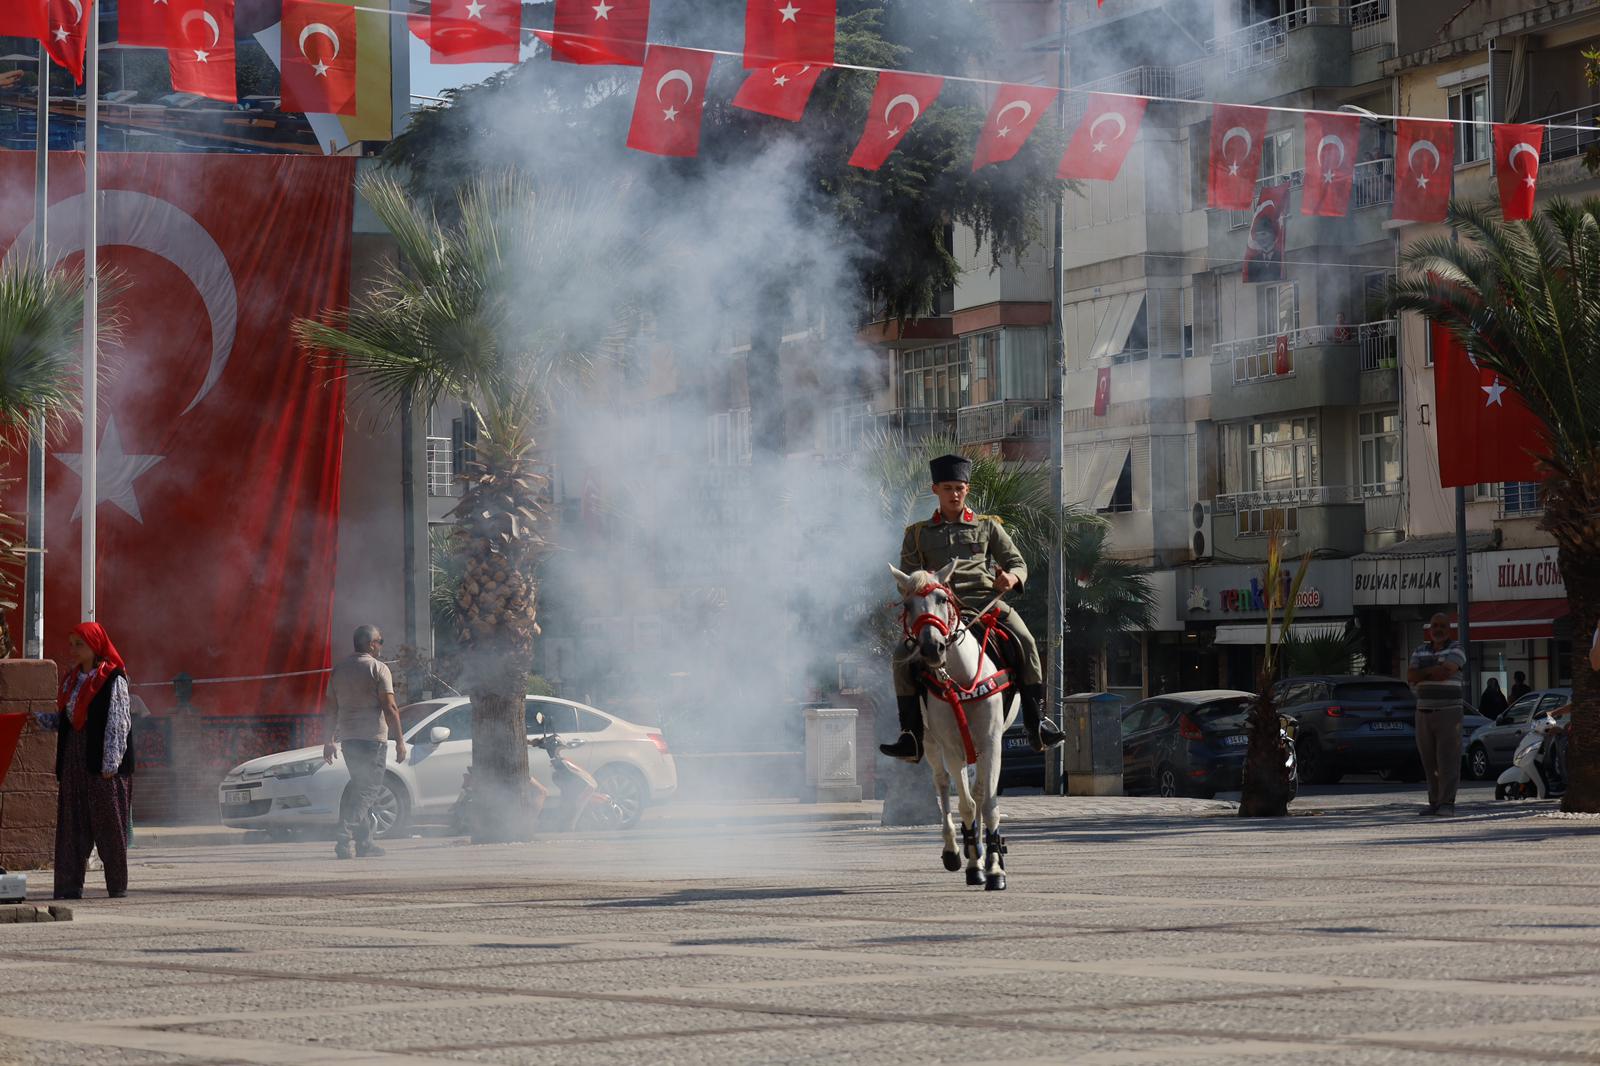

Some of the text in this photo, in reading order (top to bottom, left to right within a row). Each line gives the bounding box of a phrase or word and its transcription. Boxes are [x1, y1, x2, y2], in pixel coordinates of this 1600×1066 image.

[1355, 573, 1398, 591] BULVAR
[1401, 571, 1441, 590] EMLAK
[1498, 558, 1532, 588] HİLAL
